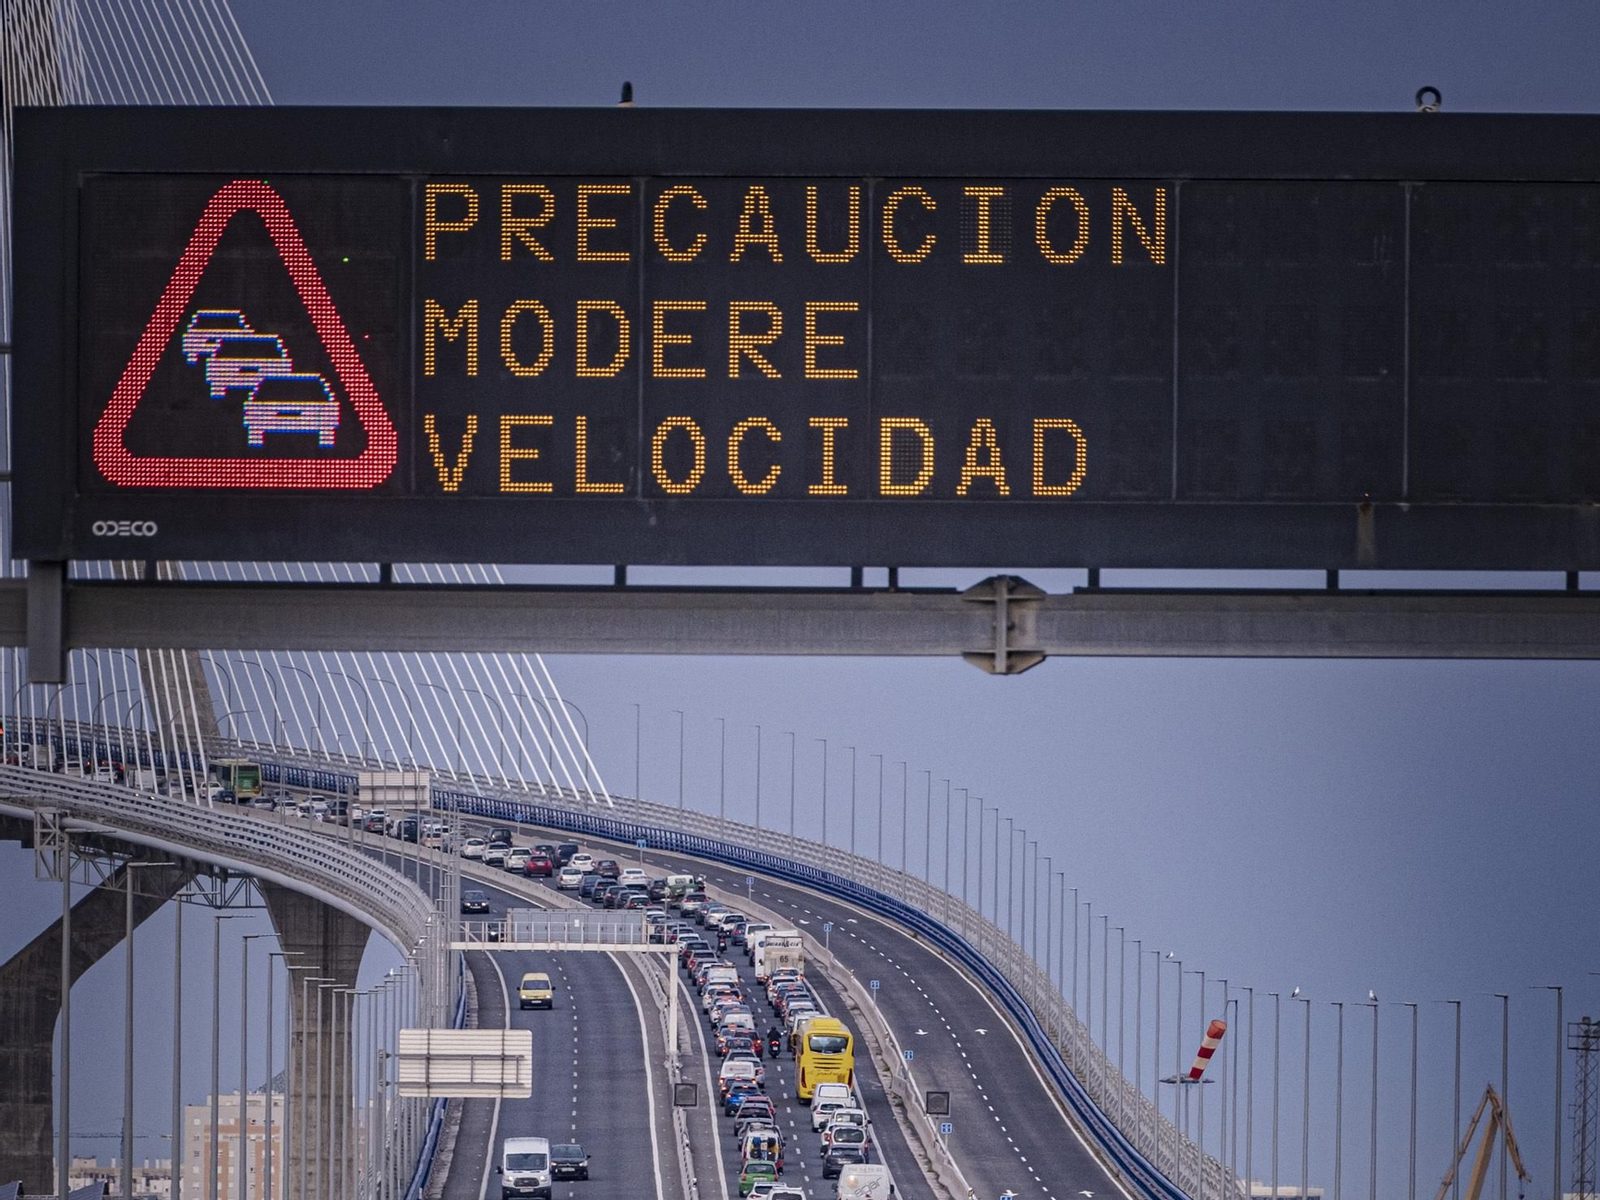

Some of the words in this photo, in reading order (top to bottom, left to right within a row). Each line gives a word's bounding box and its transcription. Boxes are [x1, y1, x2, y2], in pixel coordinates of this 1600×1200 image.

[425, 184, 1166, 265] PRECAUCION
[424, 299, 859, 380] MODERE
[424, 414, 1088, 497] VELOCIDAD
[92, 521, 159, 537] ODECO
[779, 955, 789, 963] 65
